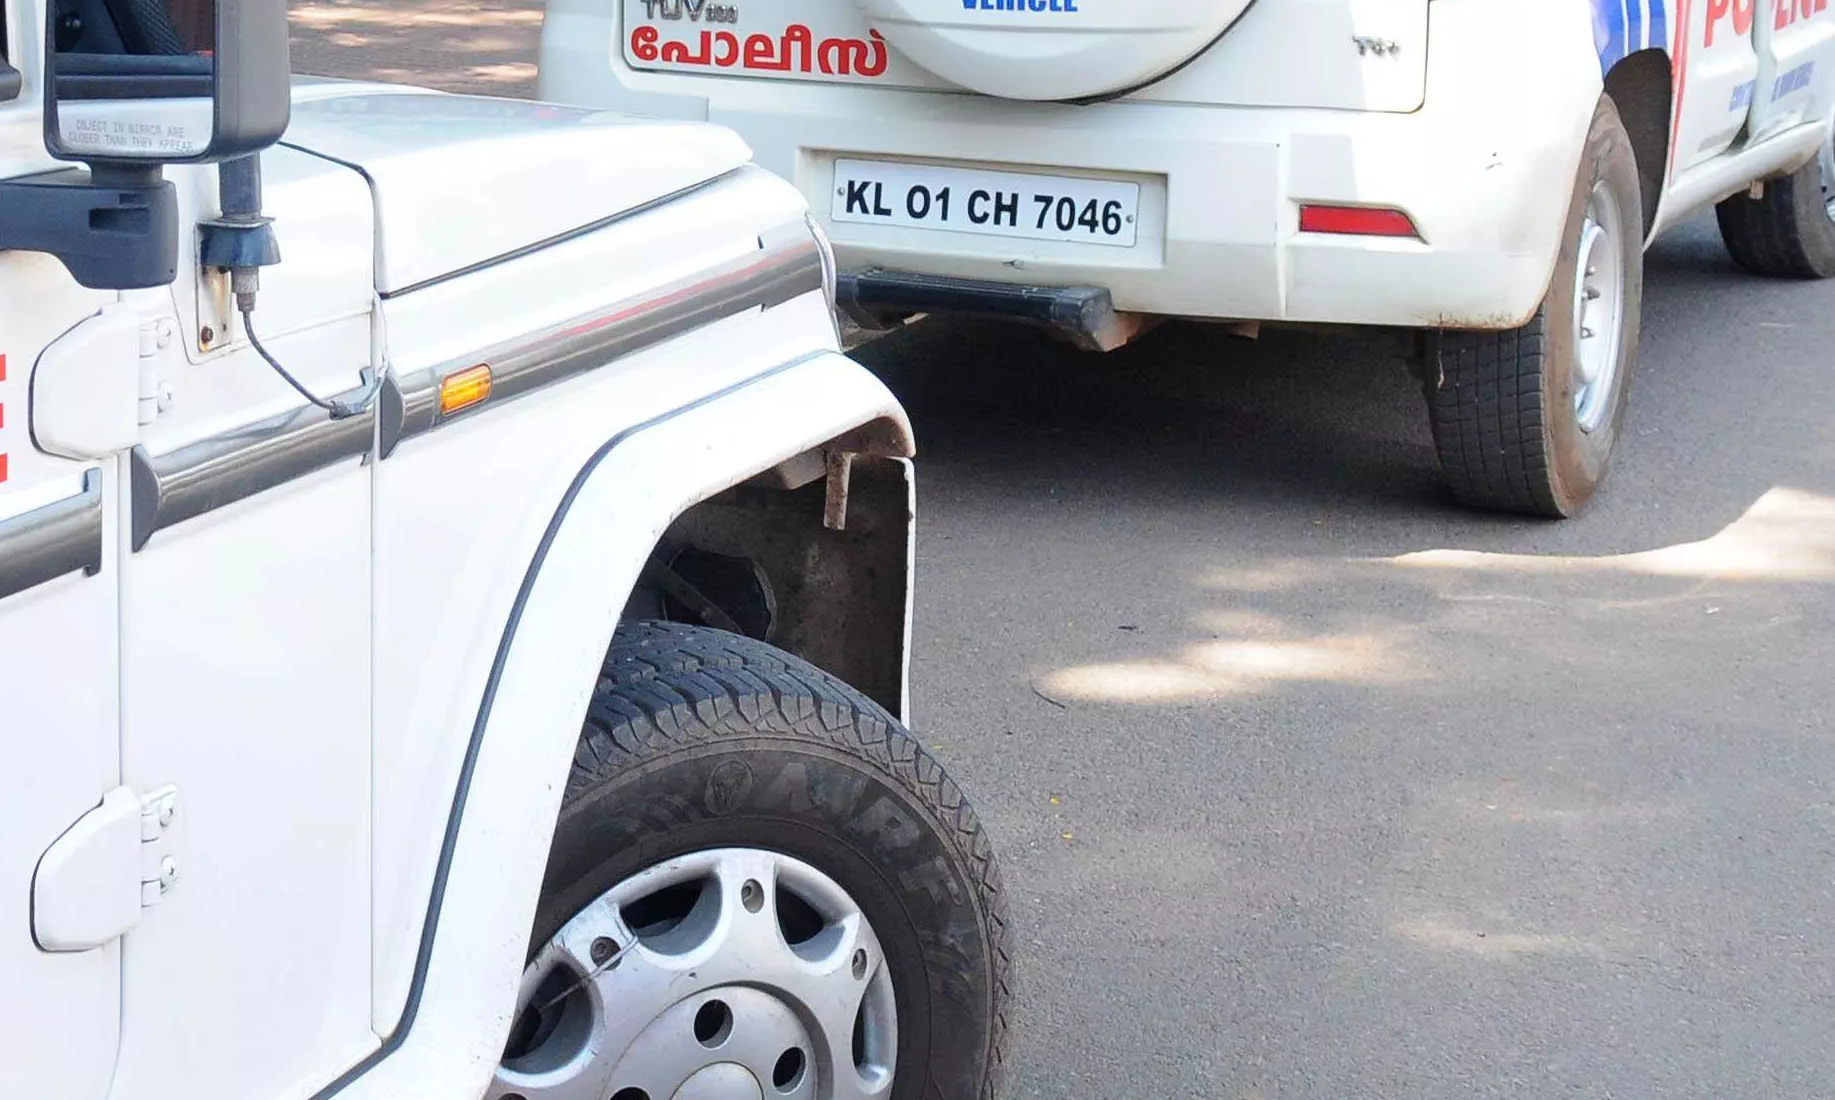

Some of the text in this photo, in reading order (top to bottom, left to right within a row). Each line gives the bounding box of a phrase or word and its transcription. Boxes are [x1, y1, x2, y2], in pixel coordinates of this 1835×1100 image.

[631, 24, 888, 77] പോലീസ്
[105, 134, 128, 147] THAN
[132, 136, 153, 148] THEY
[113, 122, 124, 134] IN
[129, 123, 163, 136] MIRROR
[167, 126, 186, 138] ARE
[845, 179, 892, 217] KL
[967, 190, 1019, 226] CH
[1033, 194, 1123, 236] 7046
